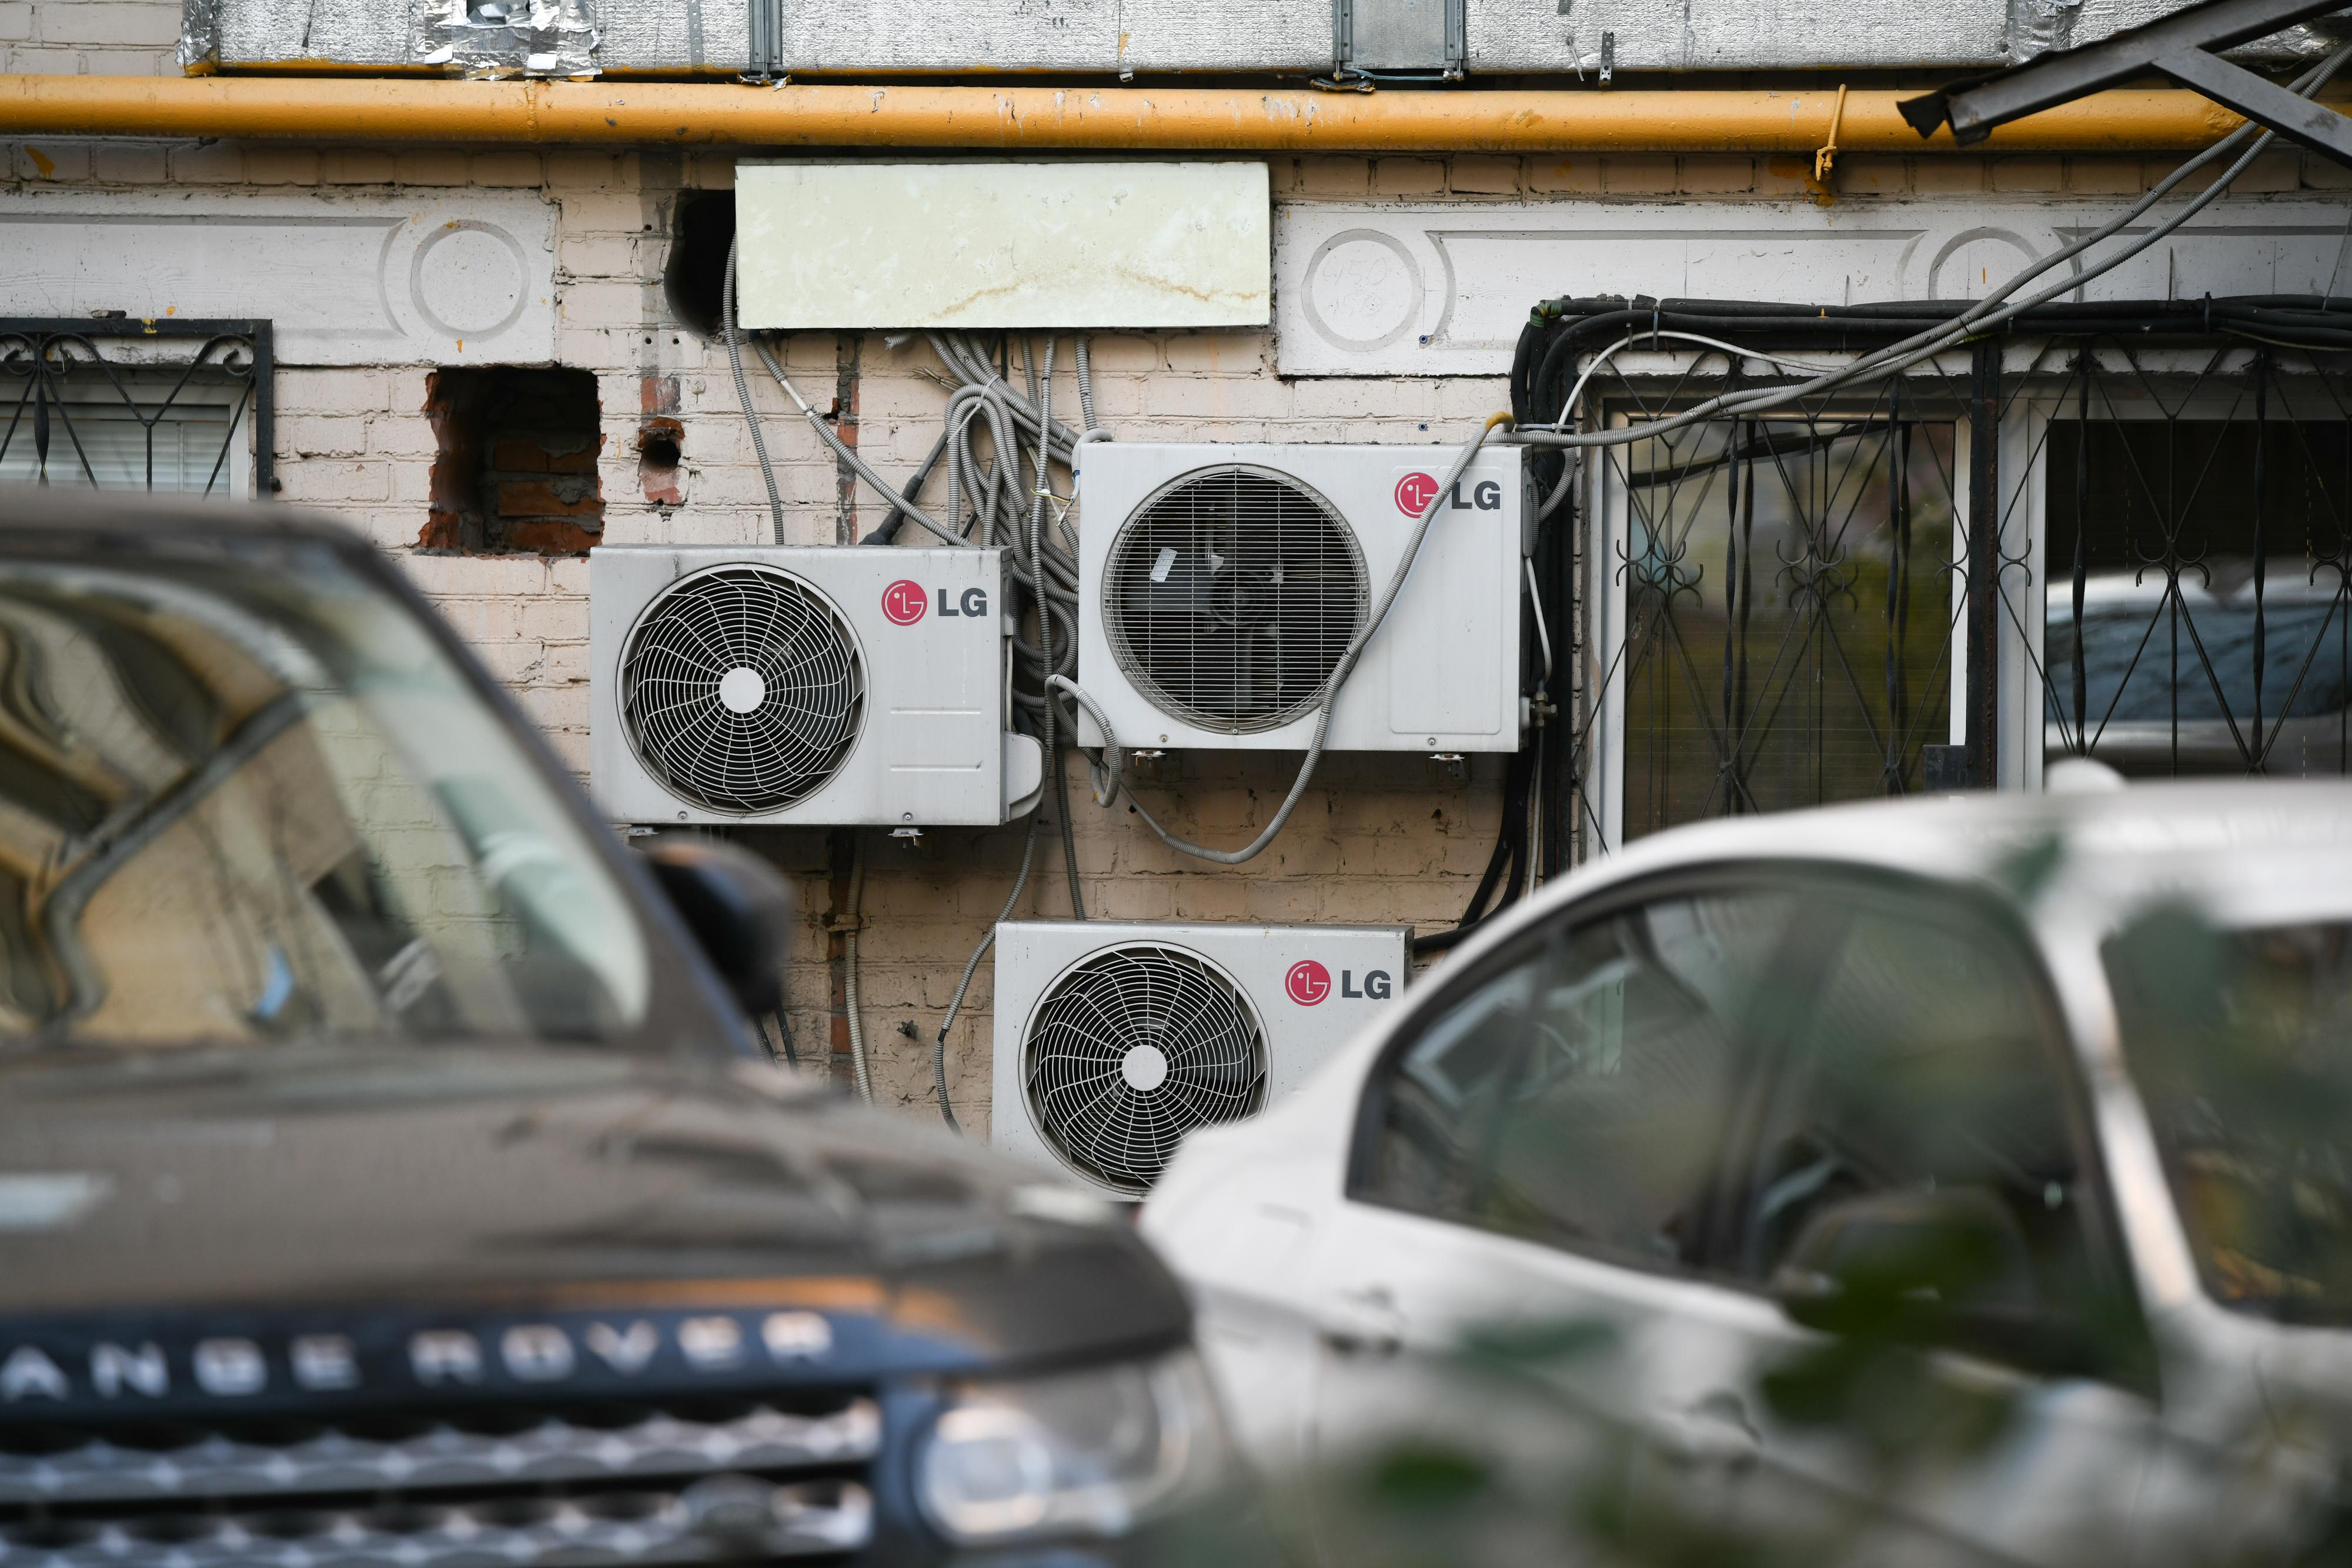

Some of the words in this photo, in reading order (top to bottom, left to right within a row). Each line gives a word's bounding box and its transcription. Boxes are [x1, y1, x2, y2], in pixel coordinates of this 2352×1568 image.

[1451, 480, 1501, 510] LG
[938, 587, 987, 617] LG
[1342, 970, 1391, 999] LG
[408, 1310, 834, 1388] ROVER
